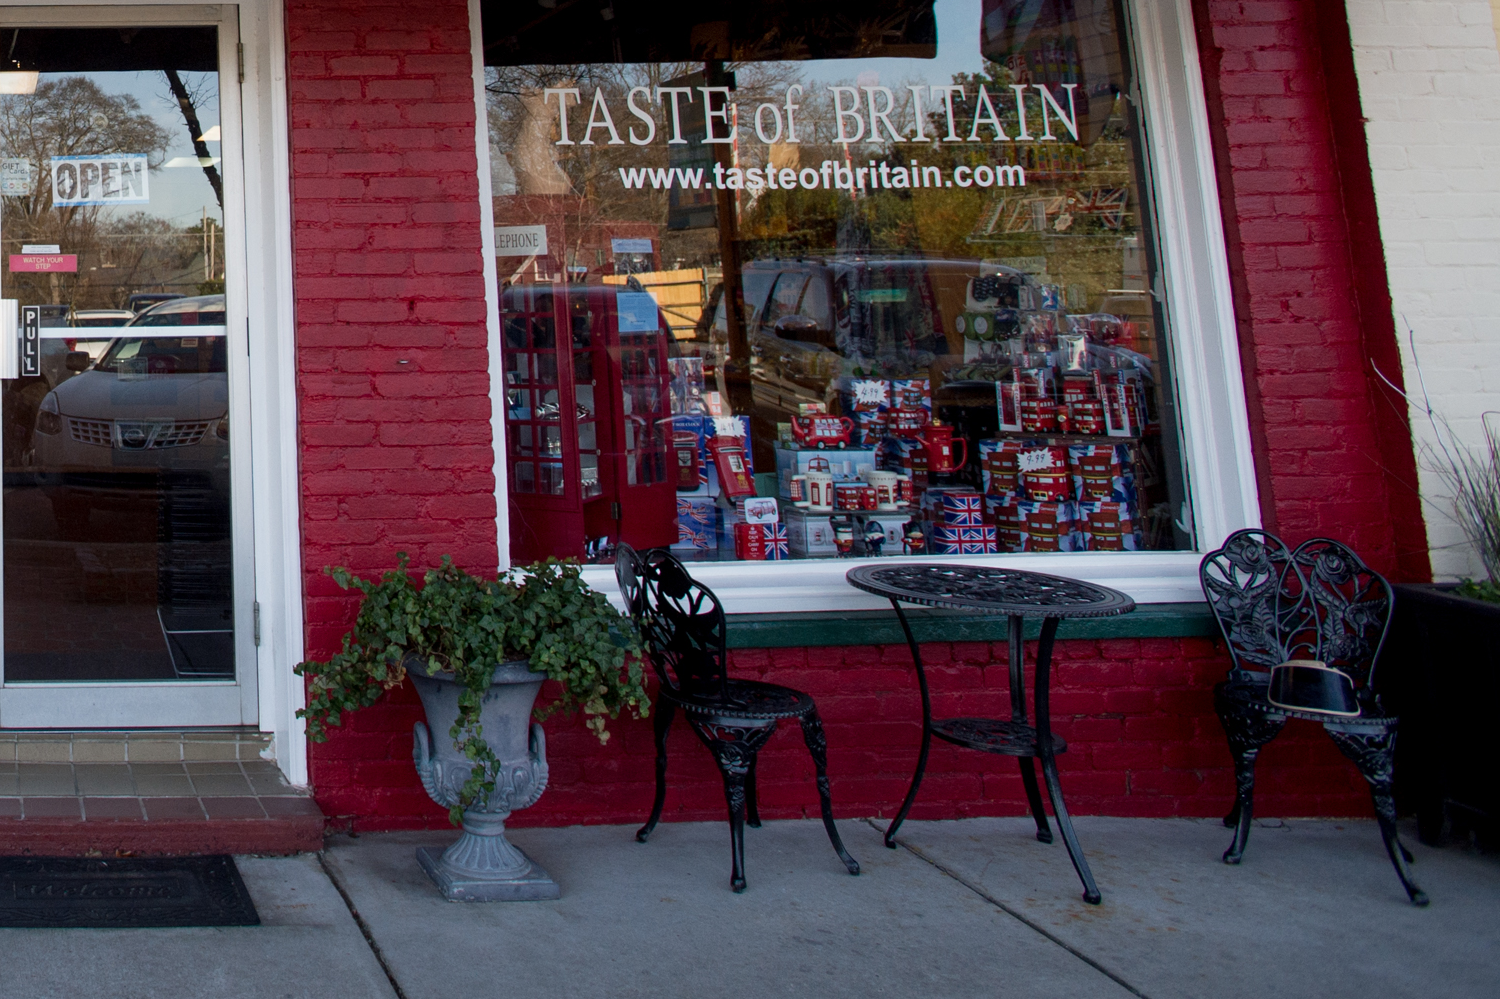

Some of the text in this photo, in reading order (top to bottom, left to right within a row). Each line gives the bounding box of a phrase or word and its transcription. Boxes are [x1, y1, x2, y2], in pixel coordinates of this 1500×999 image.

[543, 83, 1080, 146] TASTE of BRITAIN
[1, 162, 20, 170] GIFT
[618, 159, 1027, 190] www.tasteofbritain.com
[56, 161, 144, 200] OPEN
[494, 233, 540, 249] LEPHONE
[26, 311, 36, 371] PULL
[861, 387, 879, 399] 4.99
[1026, 453, 1046, 465] 9.99
